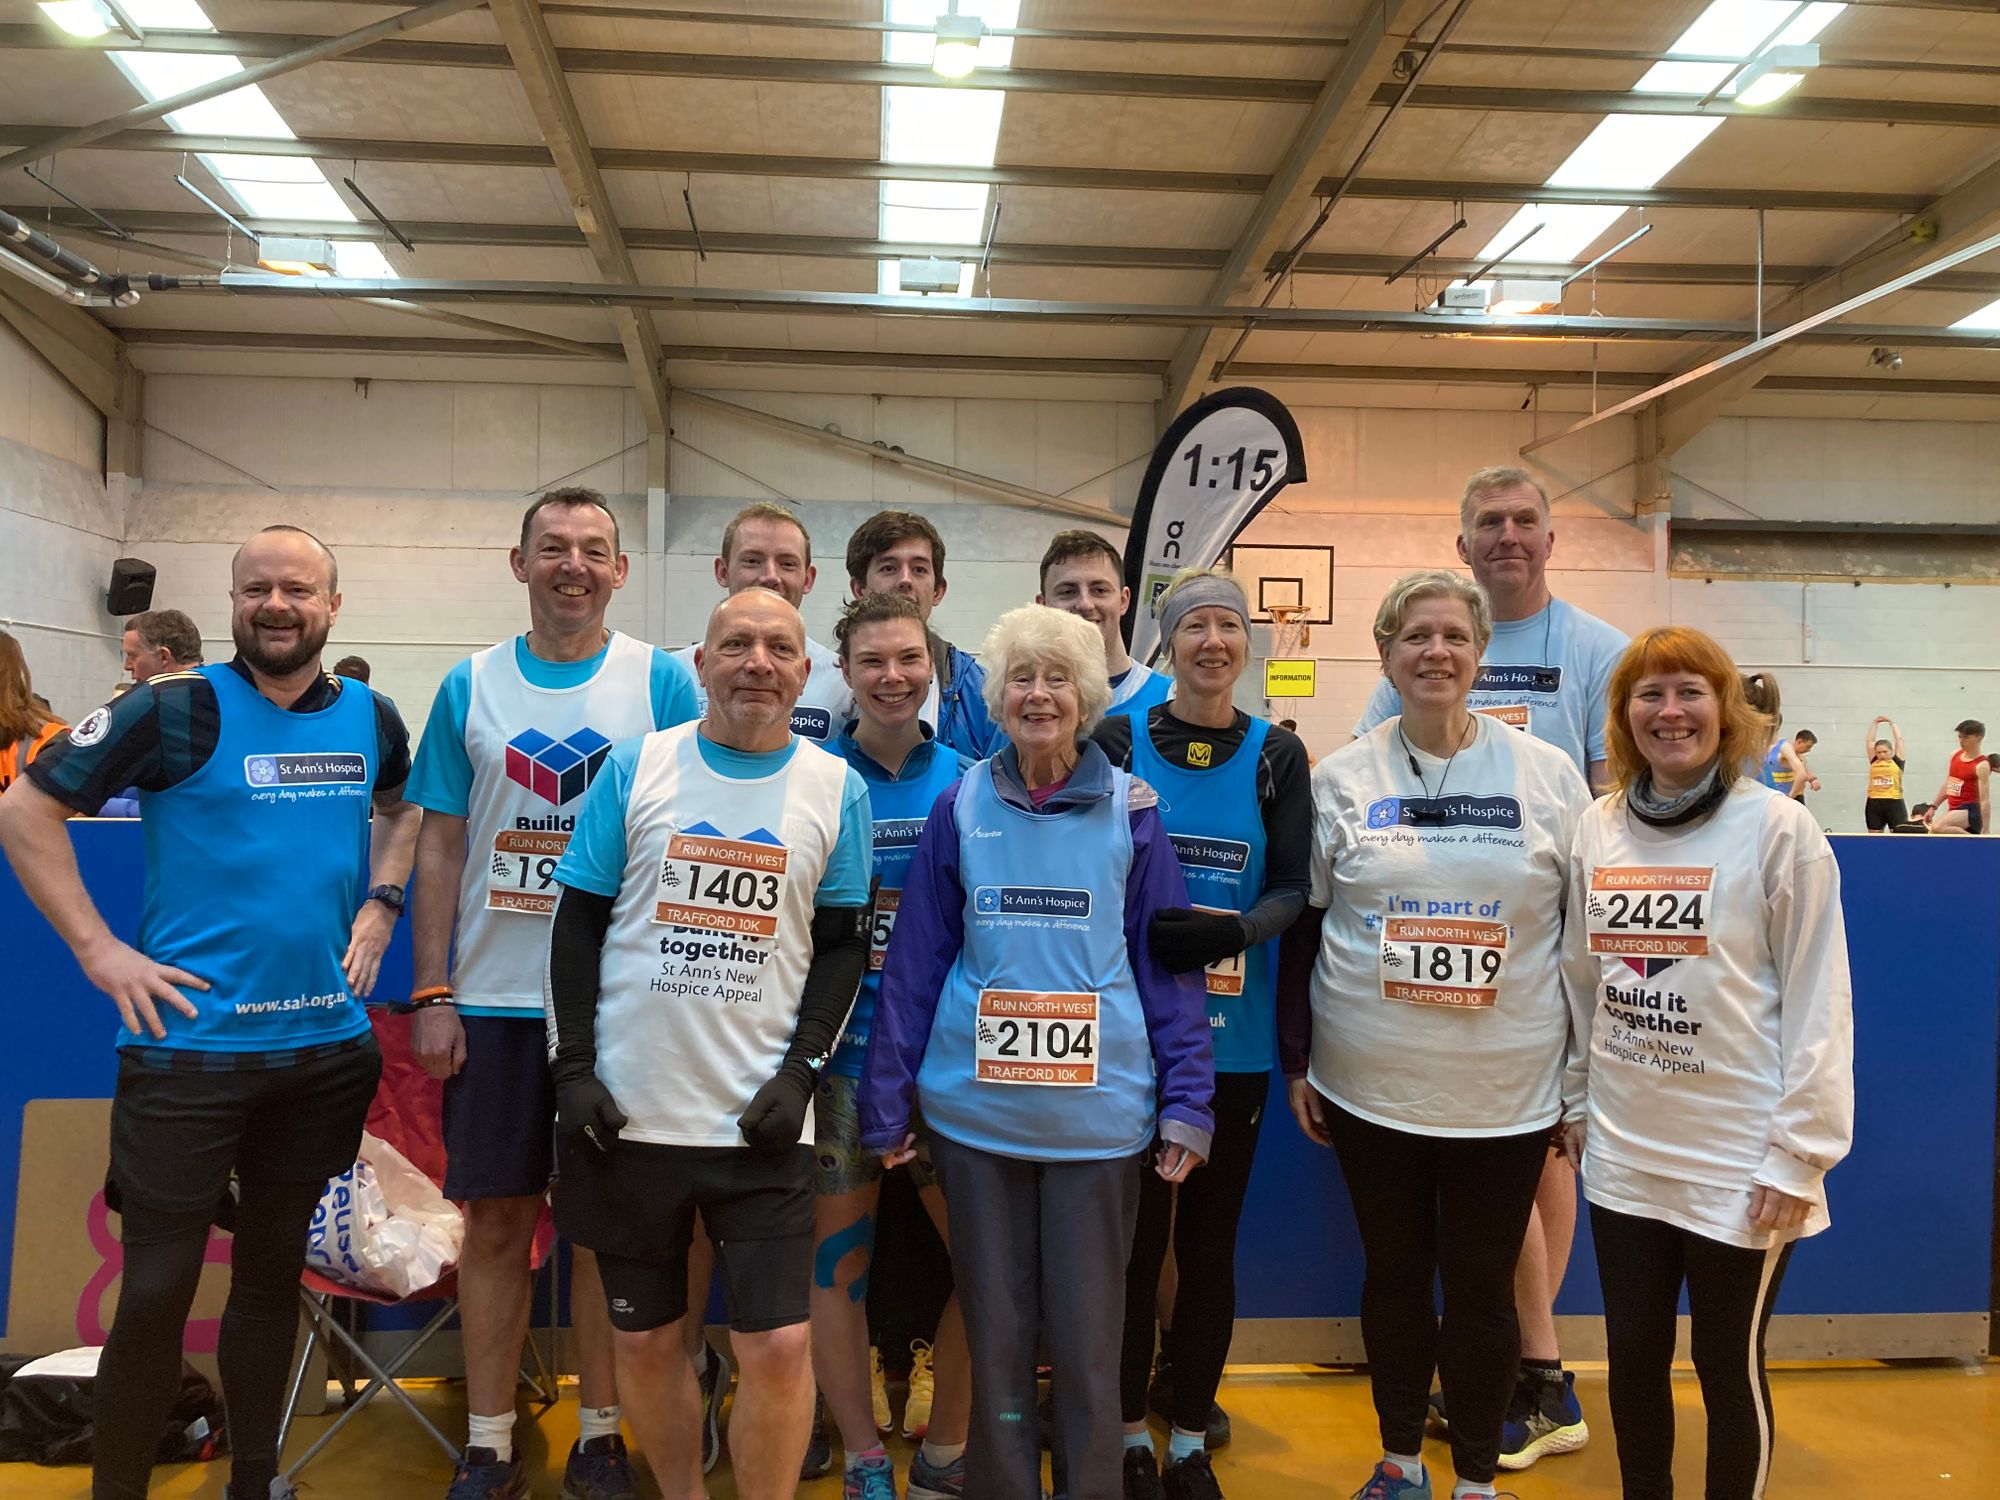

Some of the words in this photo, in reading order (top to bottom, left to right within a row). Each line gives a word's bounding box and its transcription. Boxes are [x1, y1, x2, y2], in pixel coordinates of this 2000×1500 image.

[1184, 444, 1278, 491] 1:15
[1480, 673, 1508, 683] Ann's
[1475, 698, 1502, 707] makes
[1514, 696, 1559, 708] difference
[790, 717, 825, 729] ospice
[1500, 712, 1526, 720] WEST
[280, 763, 291, 774] St
[294, 763, 323, 774] Ann's
[325, 762, 363, 775] Hospice
[251, 790, 275, 803] every
[278, 788, 296, 802] day
[298, 788, 326, 798] makes
[328, 789, 336, 797] a
[1461, 804, 1514, 819] Hospice
[516, 815, 575, 831] Build
[884, 826, 913, 838] Ann's
[1360, 836, 1389, 846] every
[1391, 831, 1414, 846] day
[1418, 833, 1456, 843] makes
[1459, 835, 1469, 843] a
[1472, 833, 1526, 848] difference
[509, 838, 534, 849] RUN
[536, 840, 568, 851] NORT
[682, 844, 707, 857] RUN
[709, 847, 752, 863] NORTH
[755, 853, 785, 868] WEST
[1203, 846, 1243, 862] Hospice
[519, 856, 558, 889] 19
[1605, 874, 1630, 885] RUN
[1631, 875, 1672, 885] NORTH
[1675, 876, 1709, 885] WEST
[688, 864, 779, 911] 1403
[501, 895, 555, 911] TRAFFOR
[1003, 894, 1013, 905] St
[1015, 895, 1043, 906] Ann's
[1045, 897, 1086, 910] Hospice
[1388, 895, 1420, 913] I'm
[1427, 900, 1472, 917] part
[1479, 899, 1502, 917] of
[667, 907, 736, 929] TRAFFORD
[739, 918, 760, 932] 10K
[1607, 893, 1704, 930] 2424
[976, 919, 995, 930] every
[996, 919, 1013, 929] day
[1015, 918, 1041, 928] makes
[1052, 920, 1090, 932] difference
[1400, 926, 1424, 938] RUN
[1427, 928, 1469, 939] NORTH
[1473, 930, 1504, 942] WEST
[660, 936, 768, 965] together
[1600, 938, 1663, 952] TRAFFORD
[1667, 940, 1688, 953] 10K
[1410, 945, 1501, 984] 1819
[661, 961, 675, 976] St
[680, 963, 721, 980] Ann's
[726, 968, 757, 985] New
[650, 977, 709, 997] Hospice
[713, 984, 762, 1004] Appeal
[1213, 979, 1230, 991] 10K
[1395, 986, 1463, 1003] TRAFFORD
[1606, 985, 1661, 1010] Build
[1667, 992, 1687, 1013] it
[993, 1000, 1016, 1011] RUN
[1019, 1001, 1060, 1013] NORTH
[1063, 1003, 1093, 1014] WEST
[1604, 1003, 1702, 1035] together
[998, 1020, 1093, 1058] 2104
[1612, 1025, 1622, 1040] St
[1623, 1031, 1654, 1050] Ann's
[1658, 1040, 1693, 1056] New
[1605, 1038, 1646, 1064] Hospice
[1650, 1054, 1705, 1074] Appeal
[988, 1066, 1054, 1080] TRAFFORD
[1058, 1069, 1077, 1080] 10K
